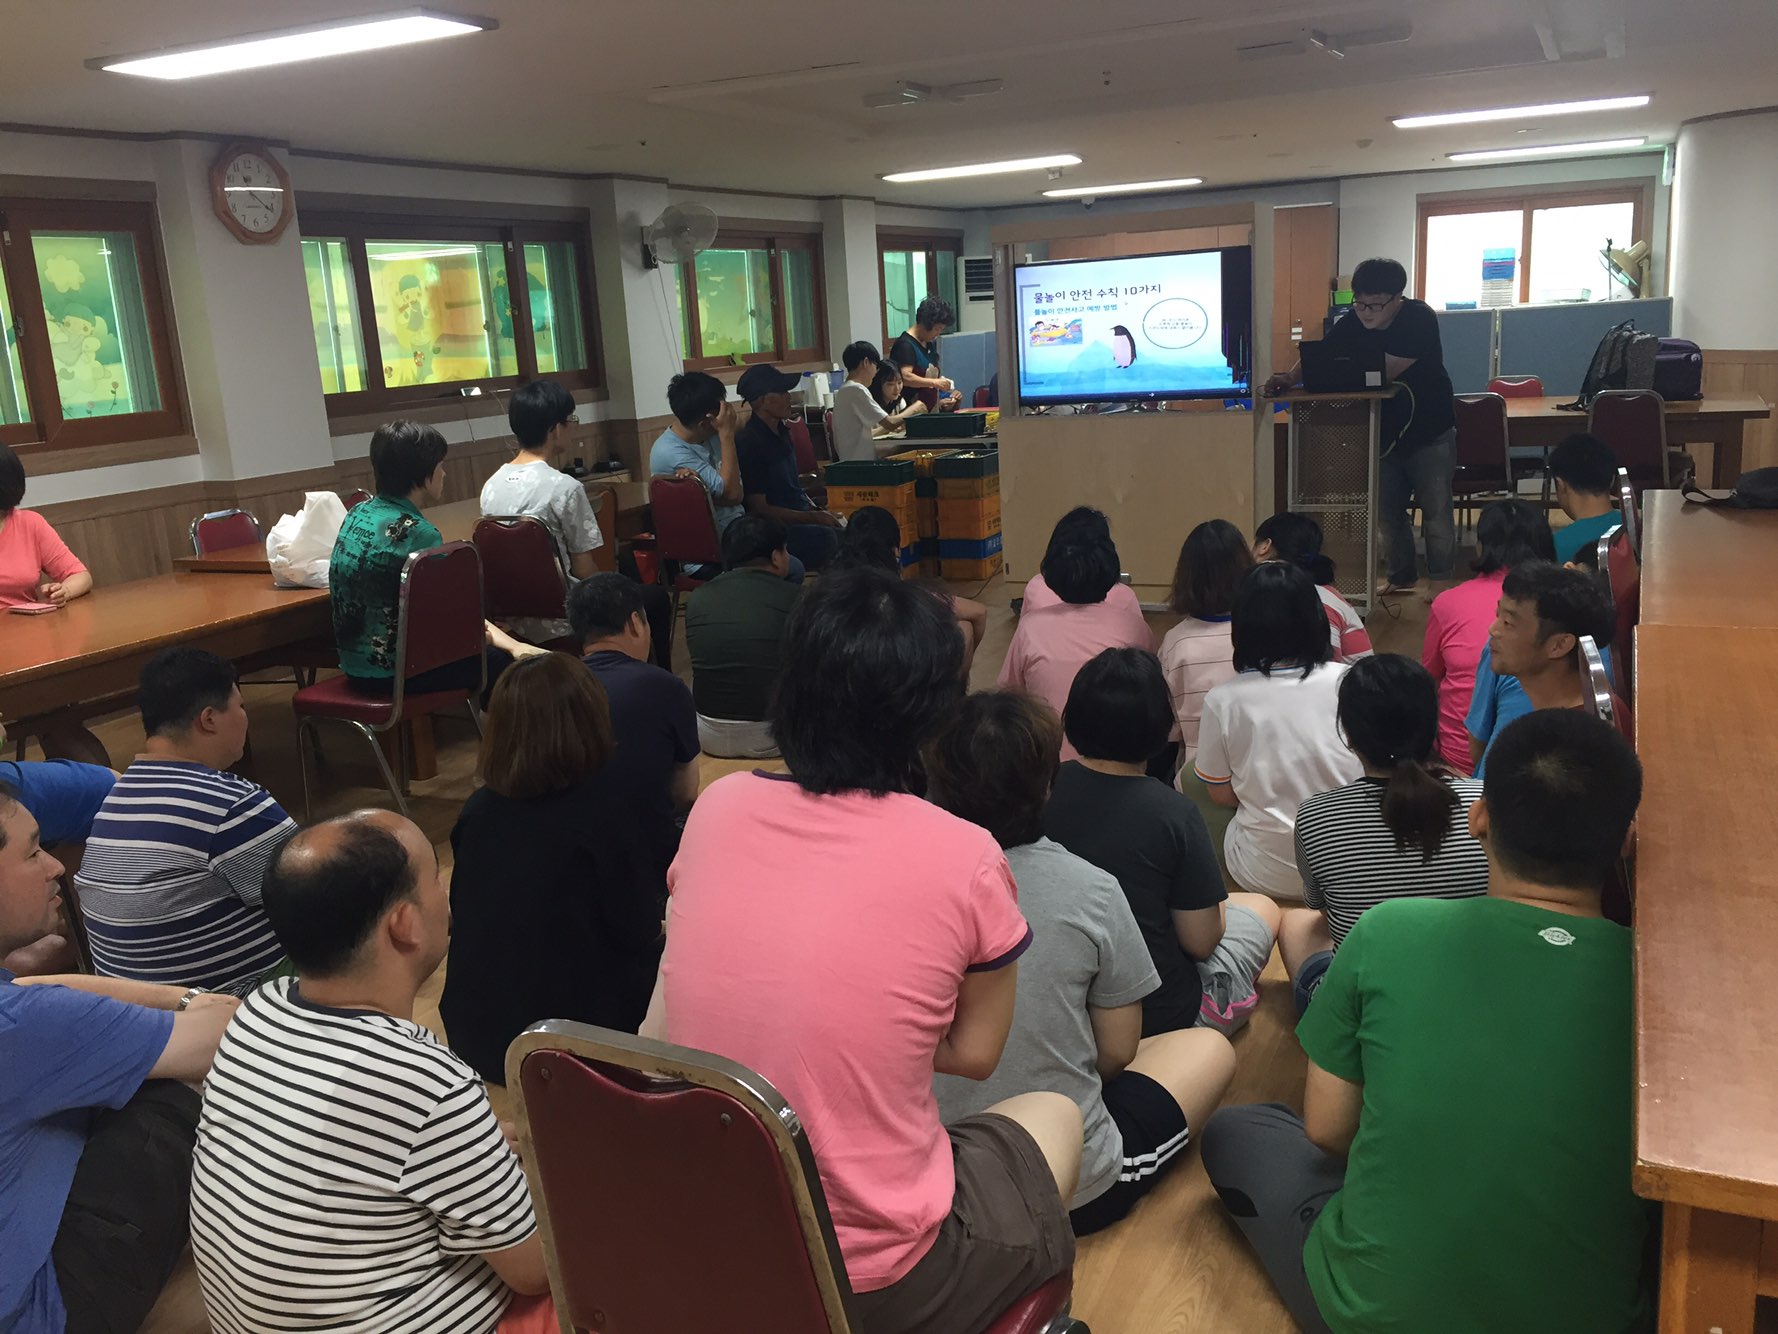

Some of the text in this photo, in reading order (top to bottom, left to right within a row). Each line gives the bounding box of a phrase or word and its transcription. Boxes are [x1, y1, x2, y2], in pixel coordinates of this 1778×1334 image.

[233, 162, 240, 173] 11
[243, 160, 251, 169] 12
[266, 174, 271, 184] 2
[231, 203, 237, 213] 8
[253, 217, 259, 227] 6
[1034, 283, 1161, 304] 물놀이 안전 수칙 10가지
[1034, 307, 1055, 316] 물놀이
